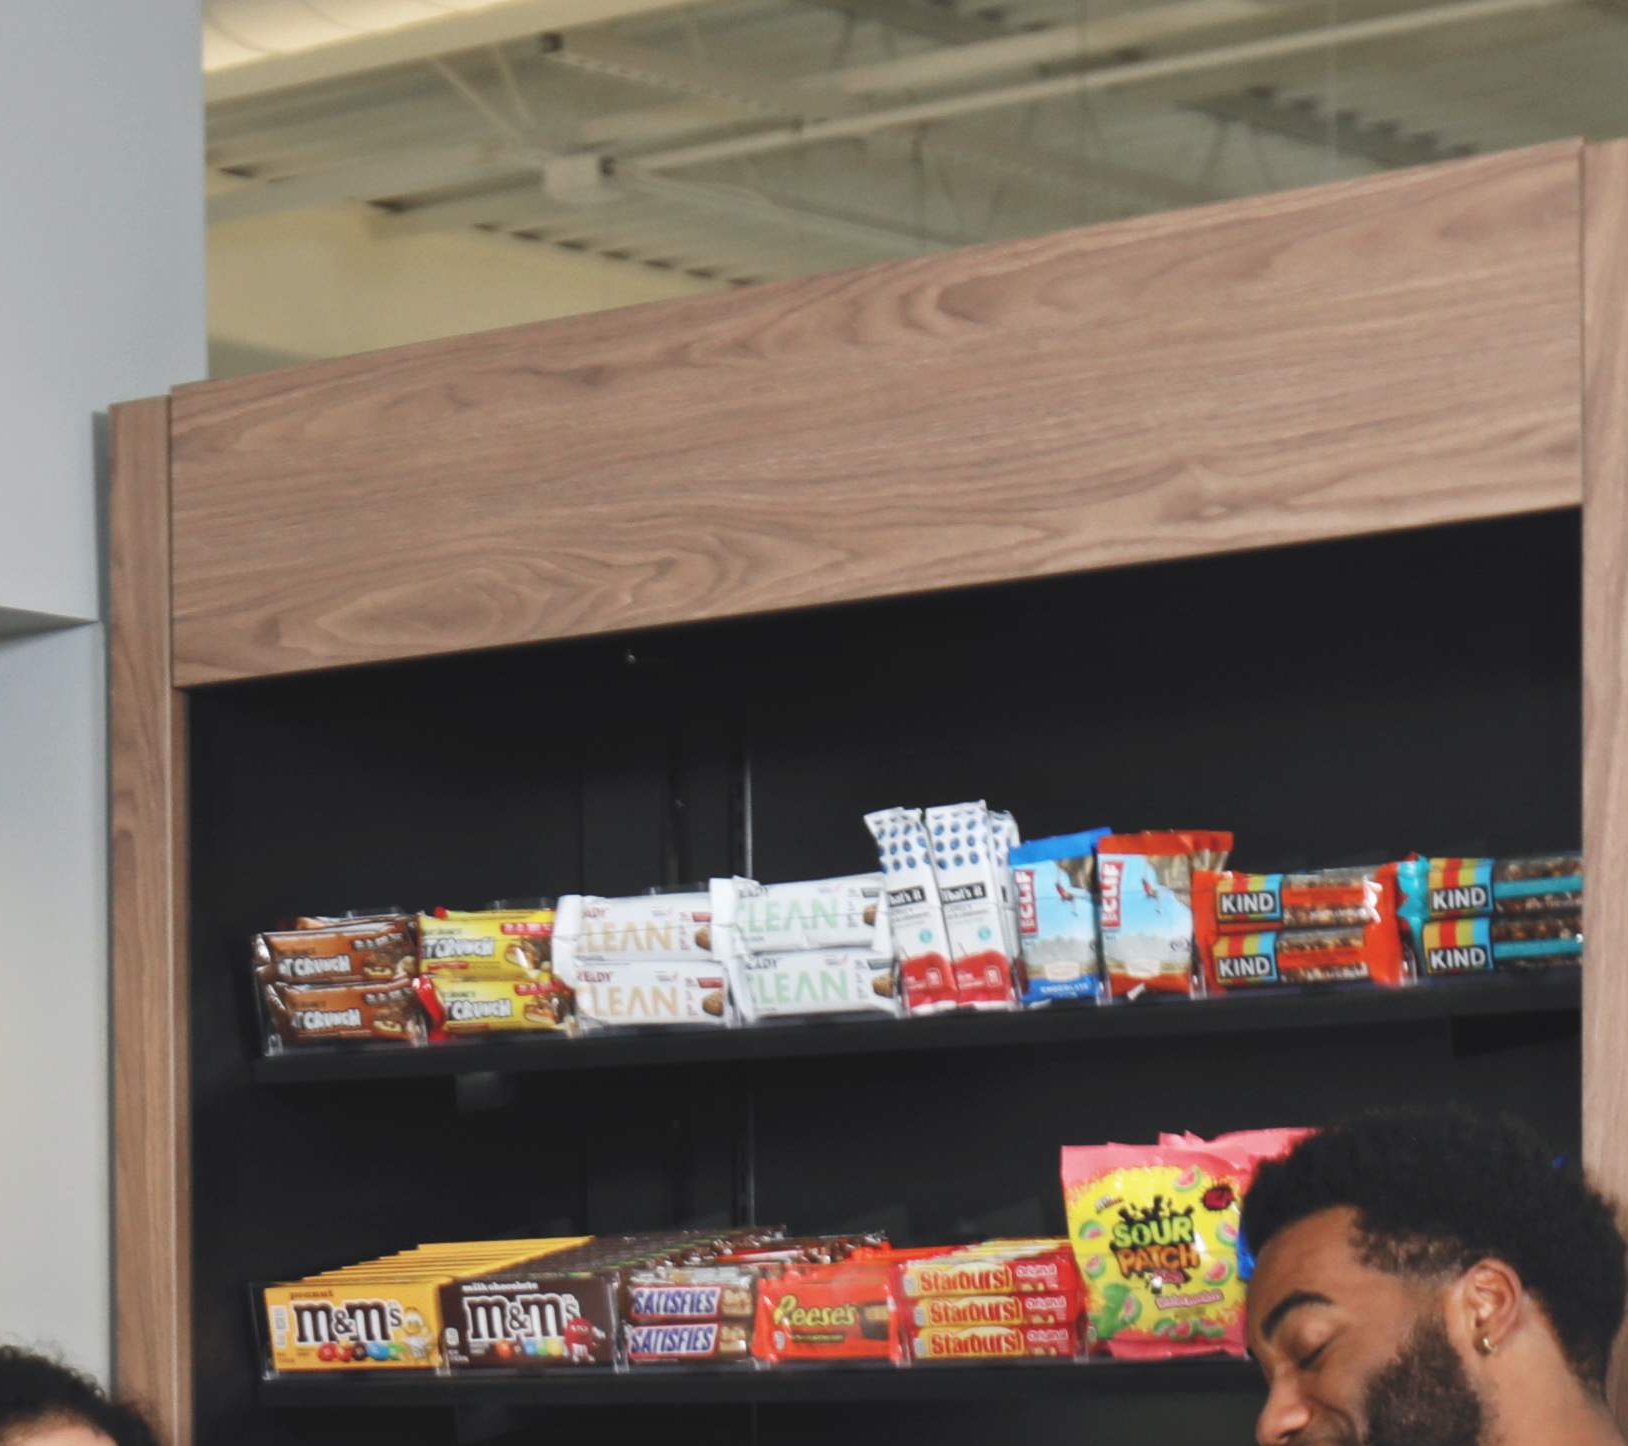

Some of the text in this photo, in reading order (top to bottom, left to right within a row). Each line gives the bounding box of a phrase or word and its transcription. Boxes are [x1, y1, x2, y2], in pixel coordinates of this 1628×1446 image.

[1221, 892, 1274, 916] KIND
[1433, 888, 1487, 910] KIND
[1218, 956, 1271, 979] KIND
[1430, 947, 1486, 971] KIND
[1113, 1216, 1194, 1248] SOUR
[1117, 1243, 1200, 1275] PATCH
[921, 1264, 1013, 1292] Starburst
[634, 1289, 717, 1318] SATISFIES
[930, 1298, 1021, 1323] Starburst
[632, 1325, 713, 1353] SATISFIES
[931, 1330, 1023, 1357] Starburst
